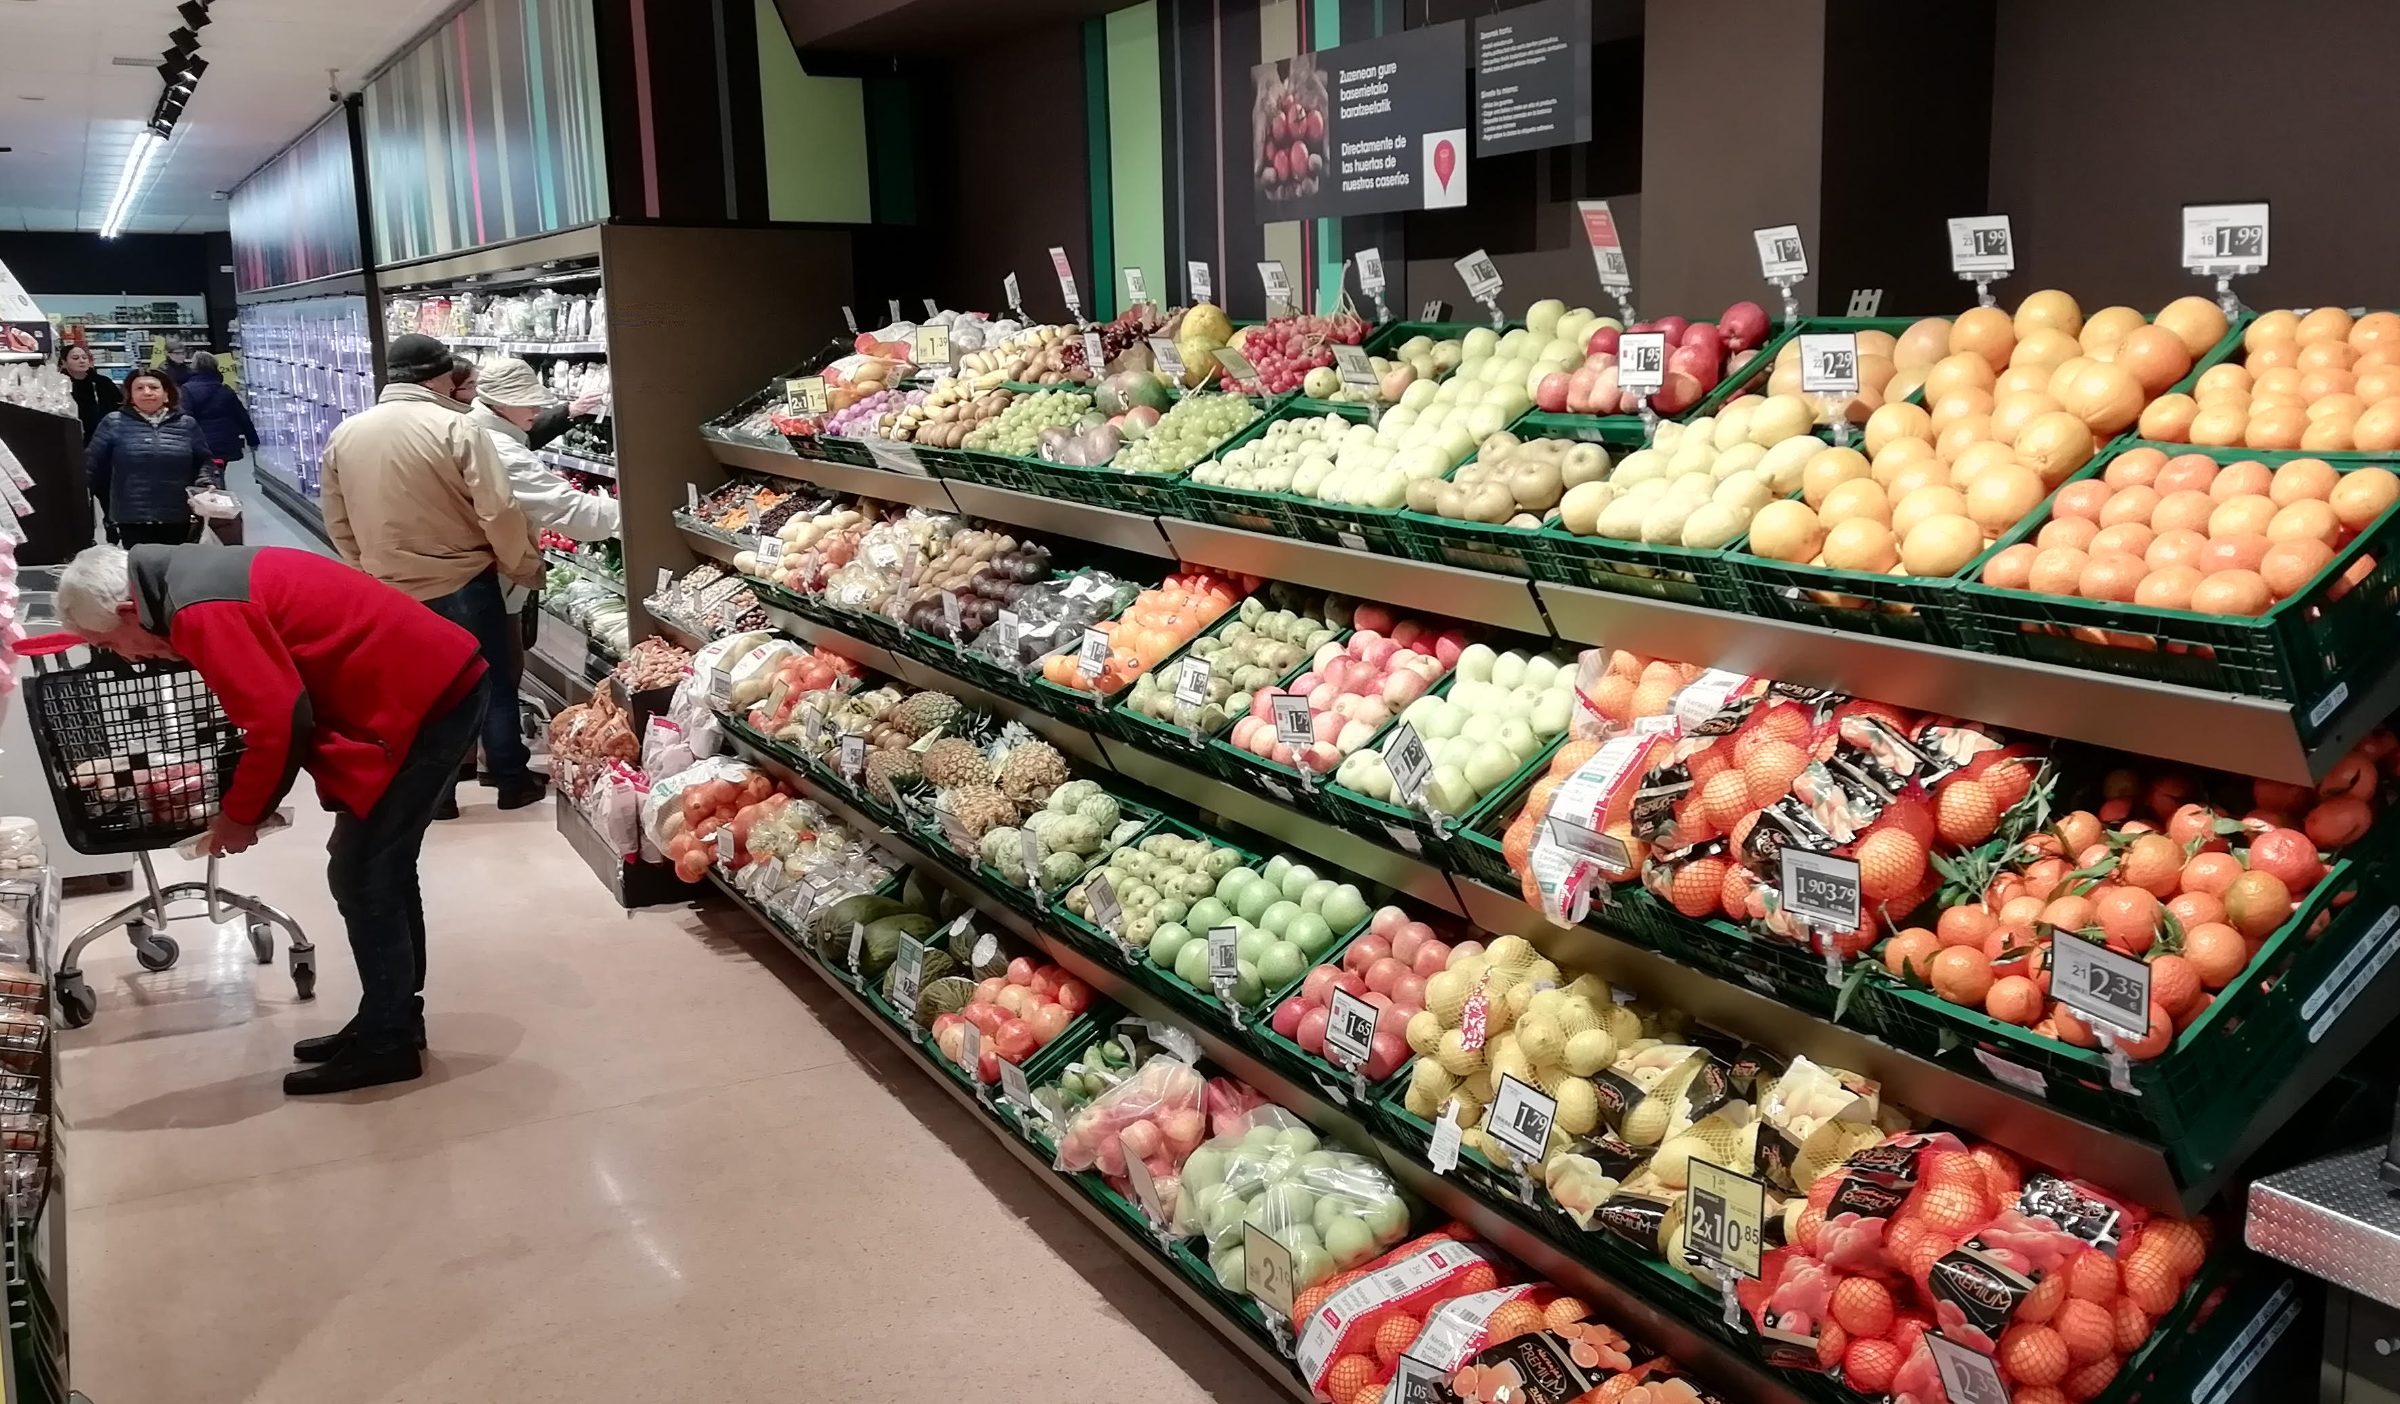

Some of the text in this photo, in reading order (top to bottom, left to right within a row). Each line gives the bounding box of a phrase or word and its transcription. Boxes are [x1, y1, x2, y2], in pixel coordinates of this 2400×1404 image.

[1339, 62, 1397, 83] Zuzenean gure
[1340, 81, 1389, 101] baserrietako
[1340, 98, 1391, 119] baratzeetatik
[1341, 134, 1407, 156] Directamente de
[1342, 154, 1397, 174] las huertas de
[1342, 170, 1410, 192] nuestros caseríos
[2201, 235, 2215, 246] 19
[2072, 964, 2087, 979] 21
[1692, 1205, 1722, 1246] 2x1
[1518, 1342, 1565, 1395] PREMIUM
